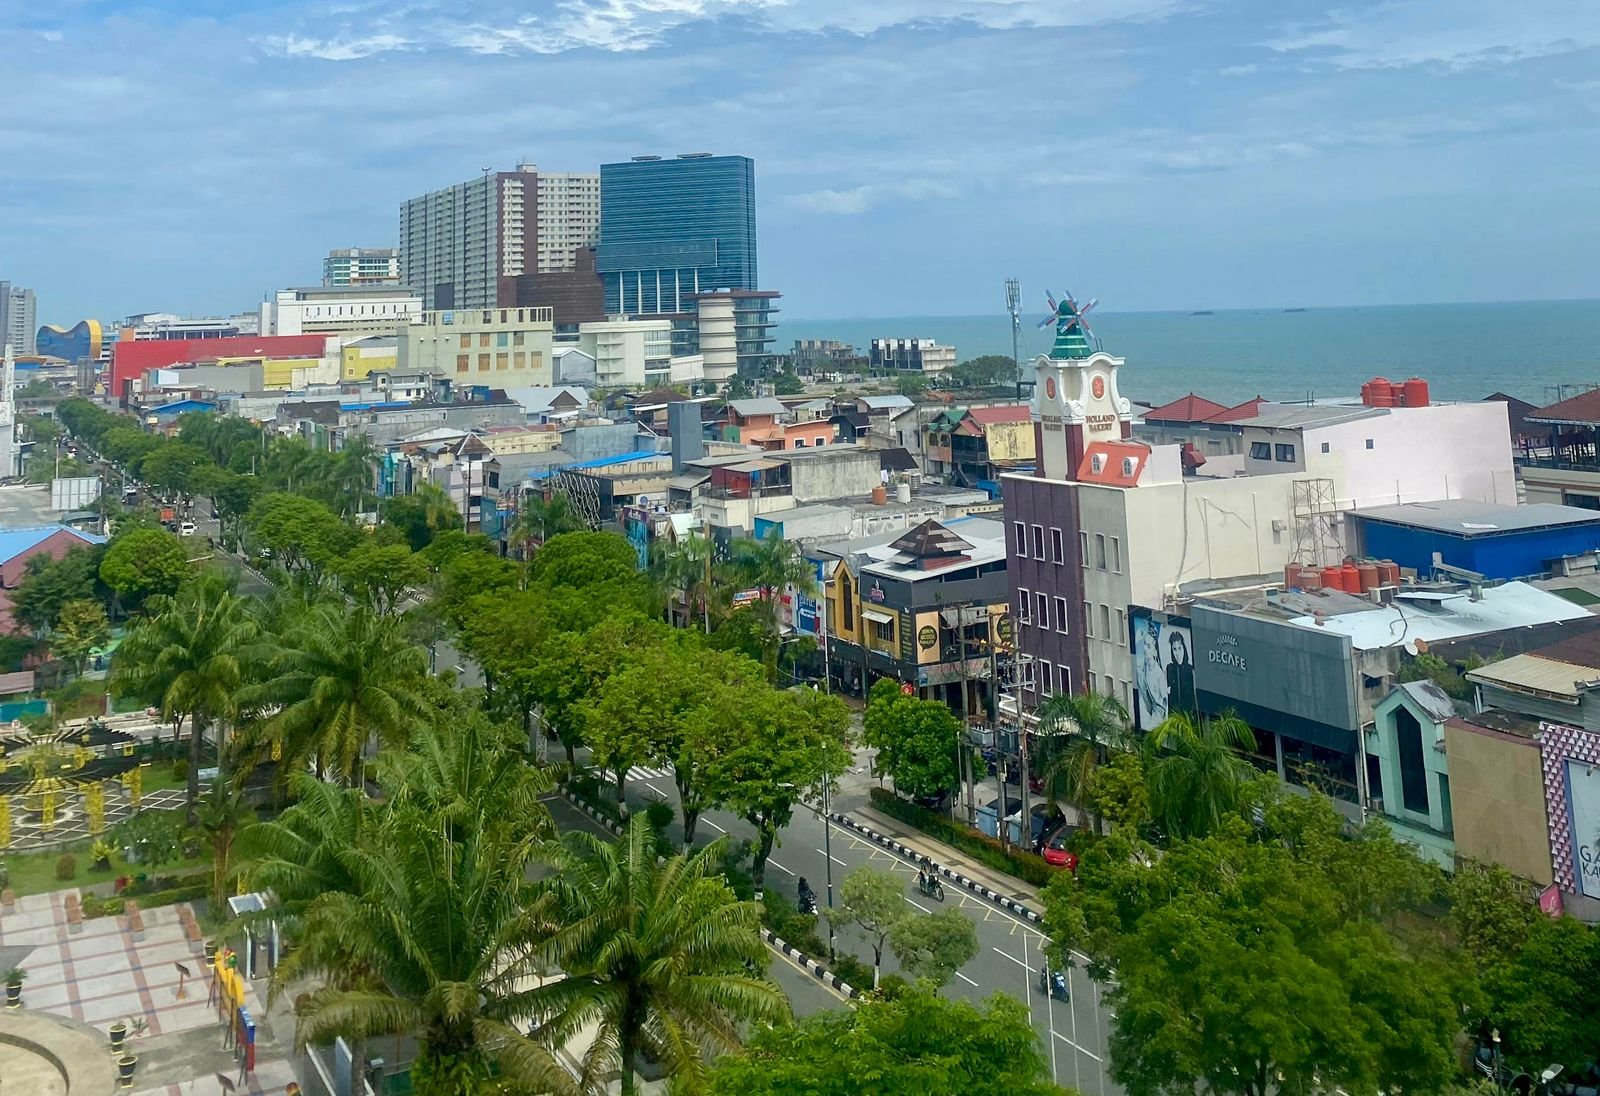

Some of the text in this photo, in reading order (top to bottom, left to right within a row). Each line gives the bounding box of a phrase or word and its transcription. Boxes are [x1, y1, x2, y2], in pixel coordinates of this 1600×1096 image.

[1085, 414, 1116, 424] HOLLAND
[1088, 423, 1113, 433] BAKERY
[1208, 650, 1247, 671] DECAFE
[1582, 861, 1600, 878] KA
